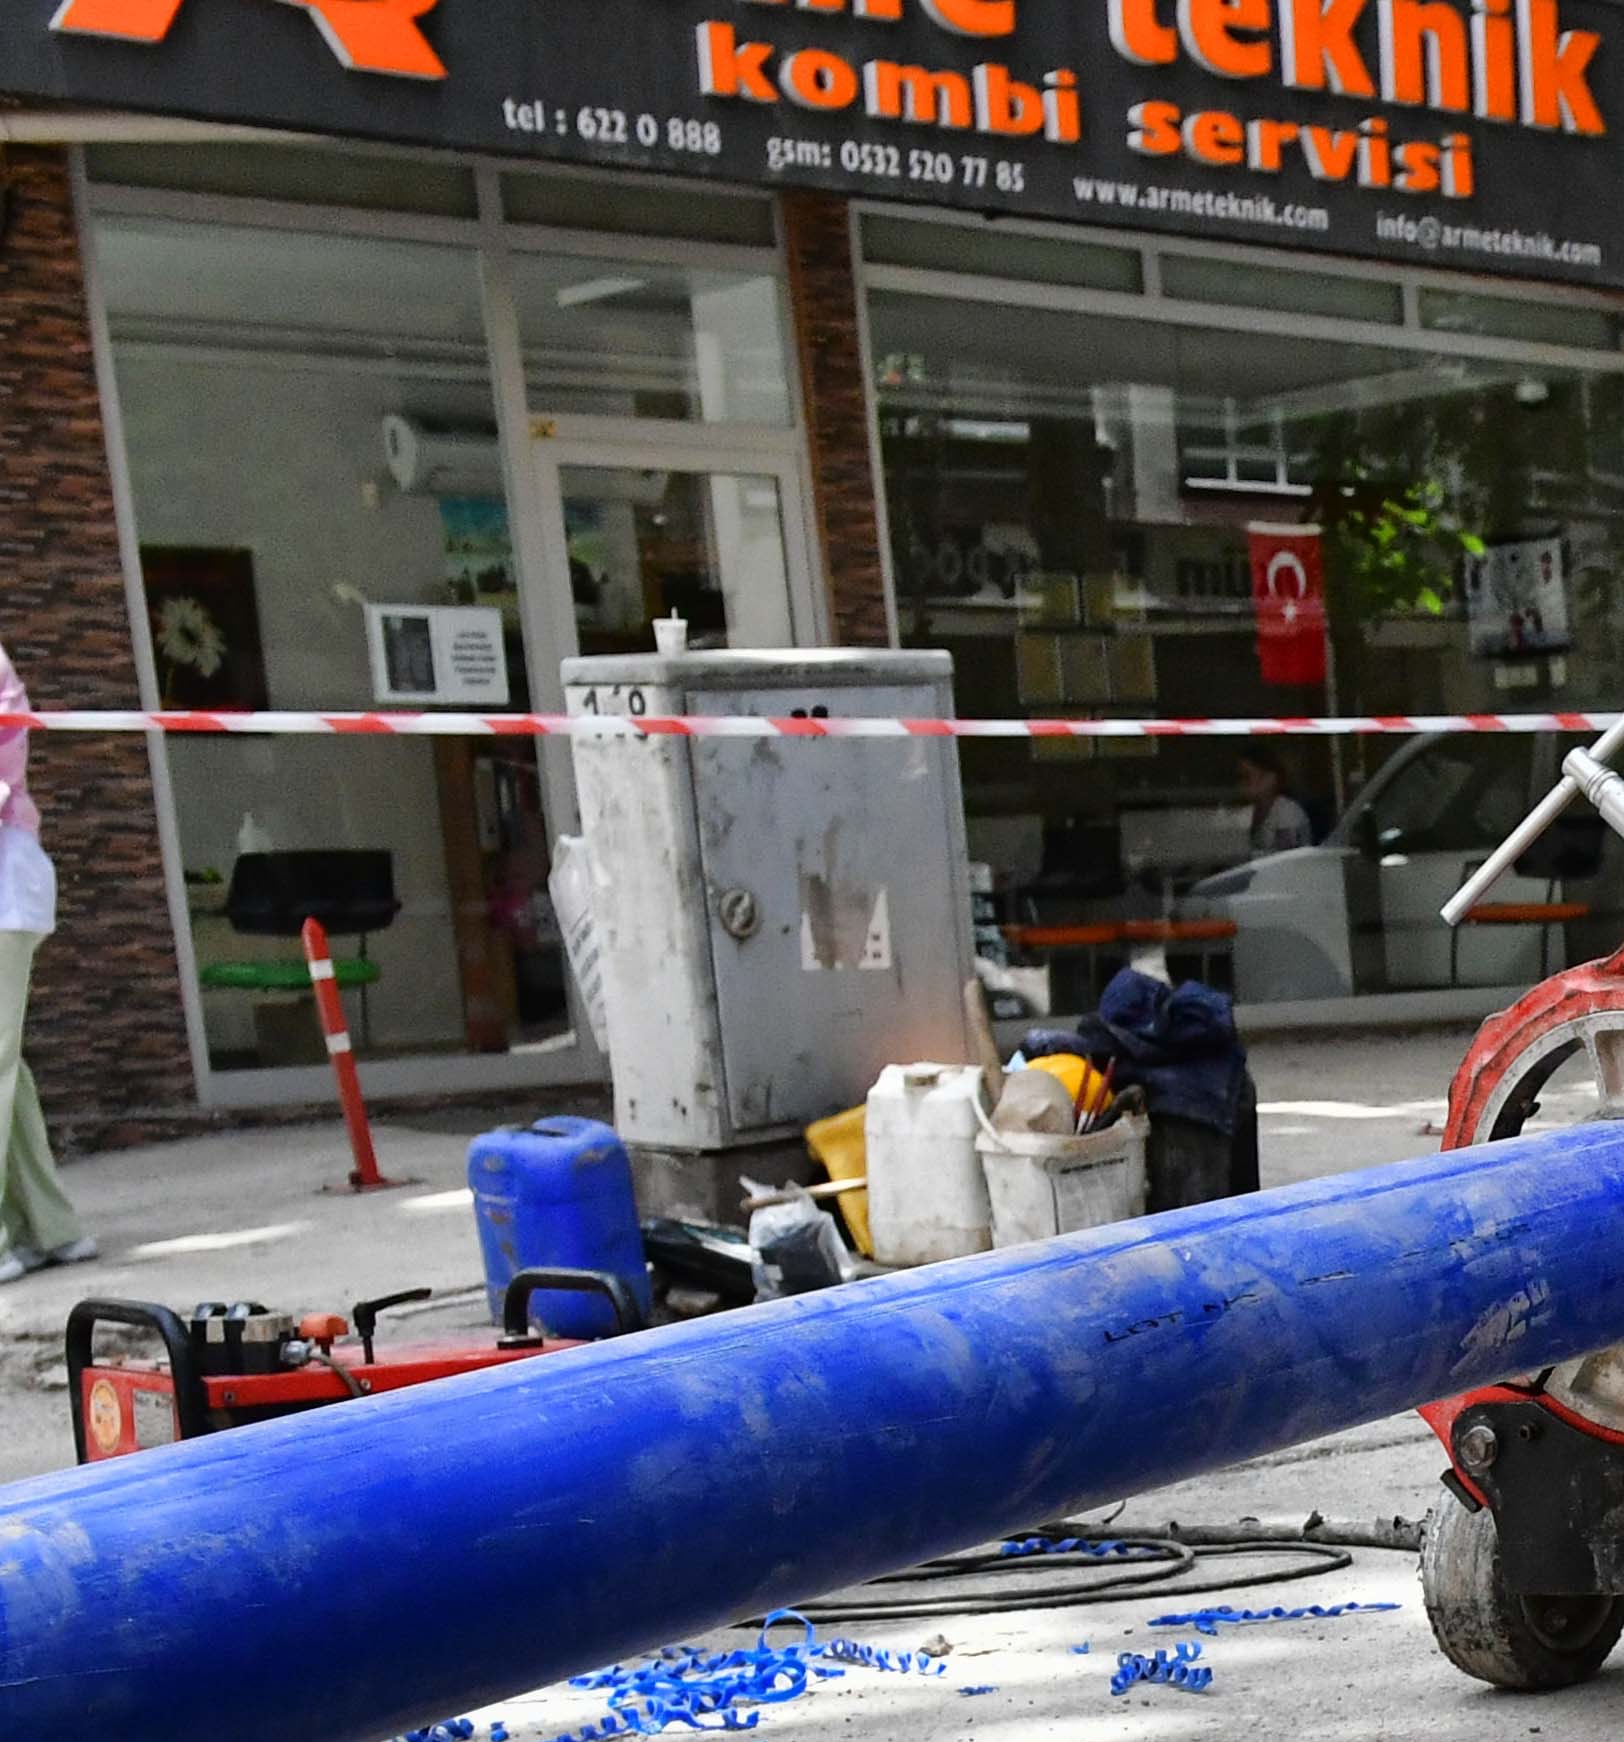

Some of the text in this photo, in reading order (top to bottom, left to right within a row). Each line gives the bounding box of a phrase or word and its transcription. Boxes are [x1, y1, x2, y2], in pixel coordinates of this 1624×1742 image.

[502, 98, 545, 132] tel
[577, 106, 628, 143] 622
[636, 113, 659, 147] 0
[667, 117, 721, 155] 888
[767, 136, 831, 171] gsm:
[840, 140, 900, 176] 0532
[909, 149, 954, 184] 520
[961, 155, 988, 188] 77
[996, 160, 1025, 192] 85
[1073, 177, 1329, 231] www.armeteknik.com
[1376, 210, 1601, 266] info@armeteknik.com
[696, 21, 1474, 198] kombi servisi
